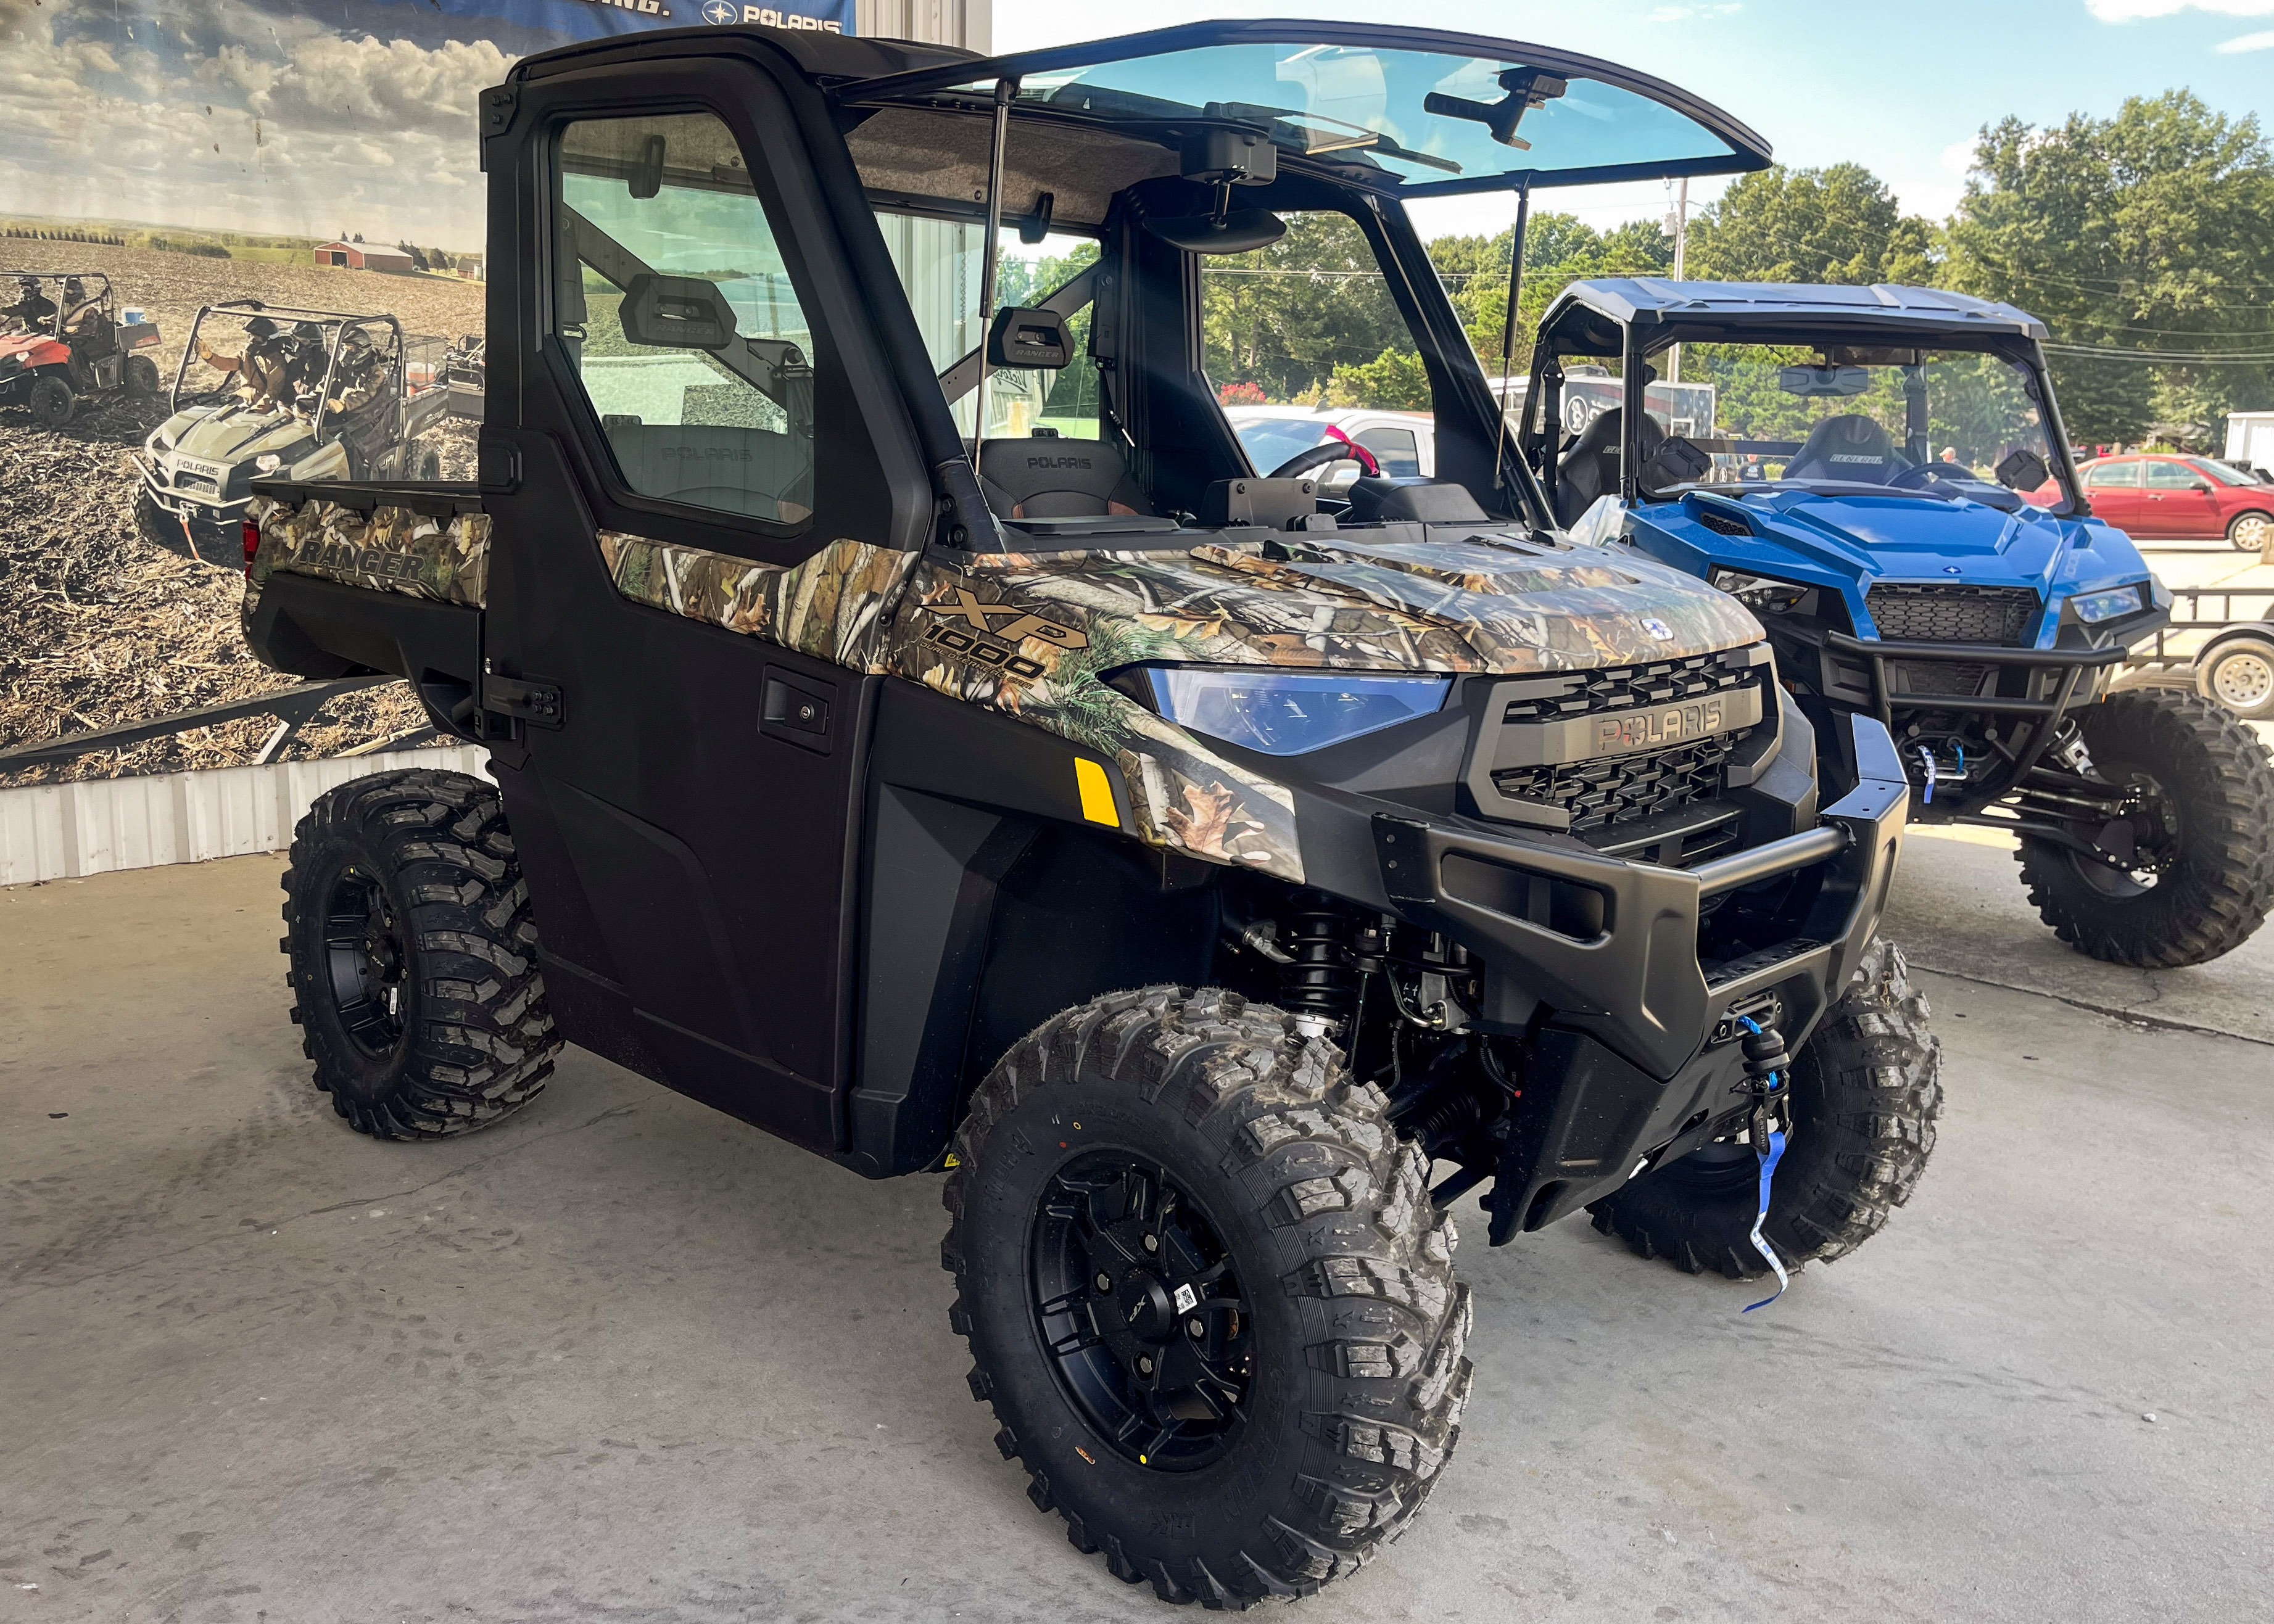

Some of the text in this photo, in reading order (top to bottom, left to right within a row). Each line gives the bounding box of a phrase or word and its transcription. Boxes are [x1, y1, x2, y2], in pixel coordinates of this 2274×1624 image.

[743, 5, 840, 35] POLARIS
[1015, 349, 1059, 358] RANGER
[176, 458, 220, 476] POLARIS
[661, 447, 753, 462] POLARIS
[1027, 456, 1092, 469] POLARIS
[1829, 453, 1883, 464] GENERAL
[299, 539, 425, 582] RANGER
[912, 584, 1089, 650] XP
[919, 641, 1035, 690] DUAL OVERHEAD CAM
[922, 622, 1048, 682] 1000
[1598, 700, 1721, 751] POLARIS
